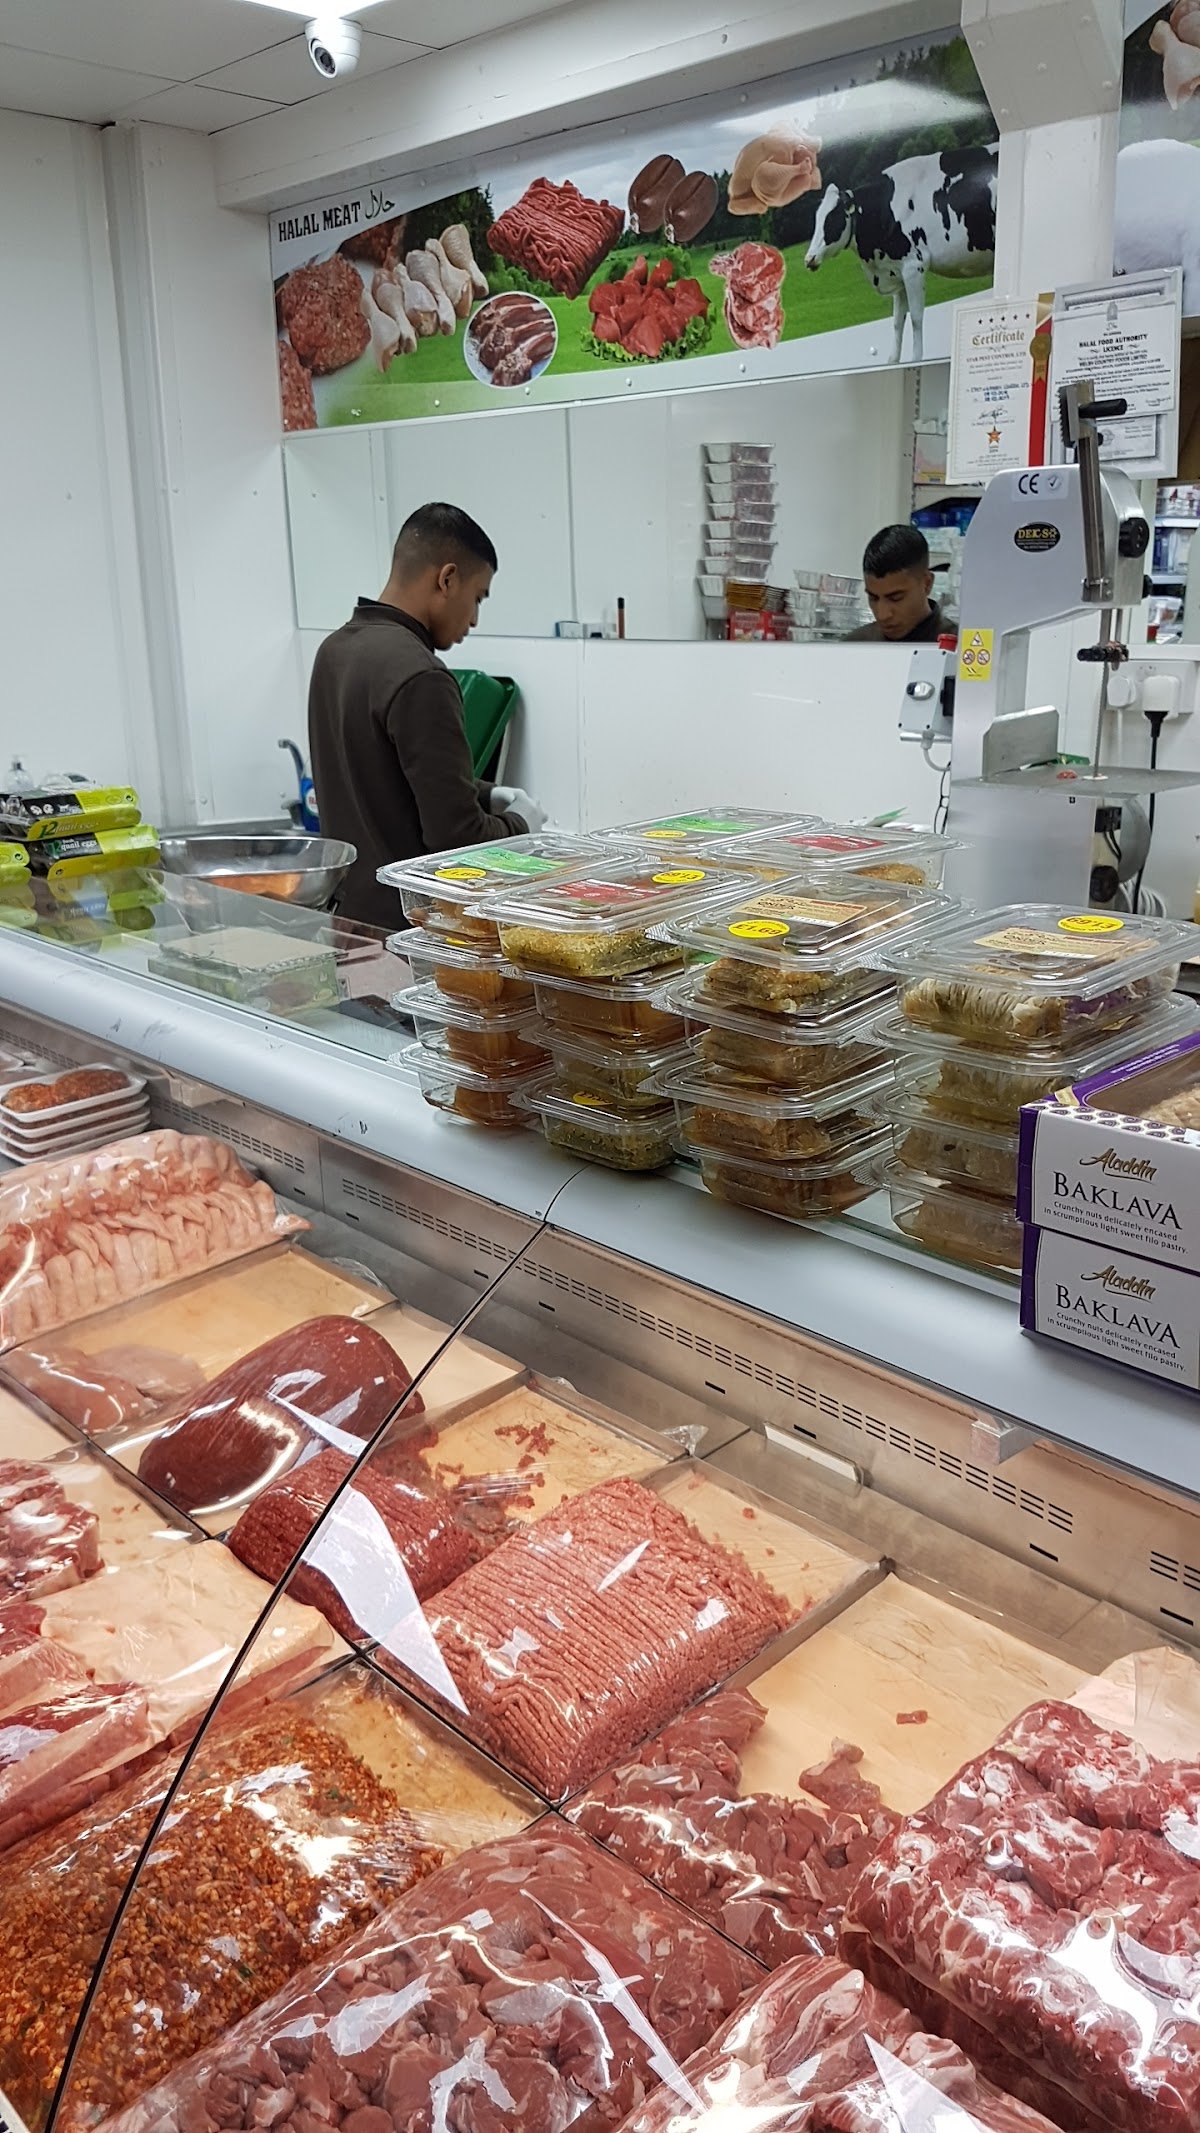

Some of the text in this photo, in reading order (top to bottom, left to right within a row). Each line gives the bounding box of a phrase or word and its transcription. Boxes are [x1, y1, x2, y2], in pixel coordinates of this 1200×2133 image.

[365, 189, 395, 219] حلال
[278, 201, 361, 242] HALAL MEAT
[972, 329, 1025, 346] Certificate
[1079, 340, 1097, 348] HALAL
[1098, 338, 1114, 346] FOOD
[1115, 333, 1149, 344] AUTHORITY
[1103, 345, 1124, 353] LICENCE
[1018, 473, 1040, 495] CE
[39, 821, 58, 838] 12
[55, 822, 77, 835] quail
[61, 841, 80, 852] quail
[81, 840, 97, 849] eggs
[733, 923, 782, 936] £1.69
[1067, 916, 1118, 930] £1.69
[1079, 1148, 1158, 1183] Aladdin
[1053, 1171, 1183, 1230] BAKLAVA
[1044, 1207, 1189, 1255] in scrumptious light sweet filo pastry.
[1054, 1201, 1178, 1241] Crunchy nuts delicately encased
[1080, 1265, 1157, 1299] Aladdin
[1055, 1284, 1181, 1349] BAKLAVA
[1047, 1317, 1187, 1372] in scrumptious light sweet filo pastry.
[1056, 1312, 1176, 1359] Crunchy nuts delicately encased
